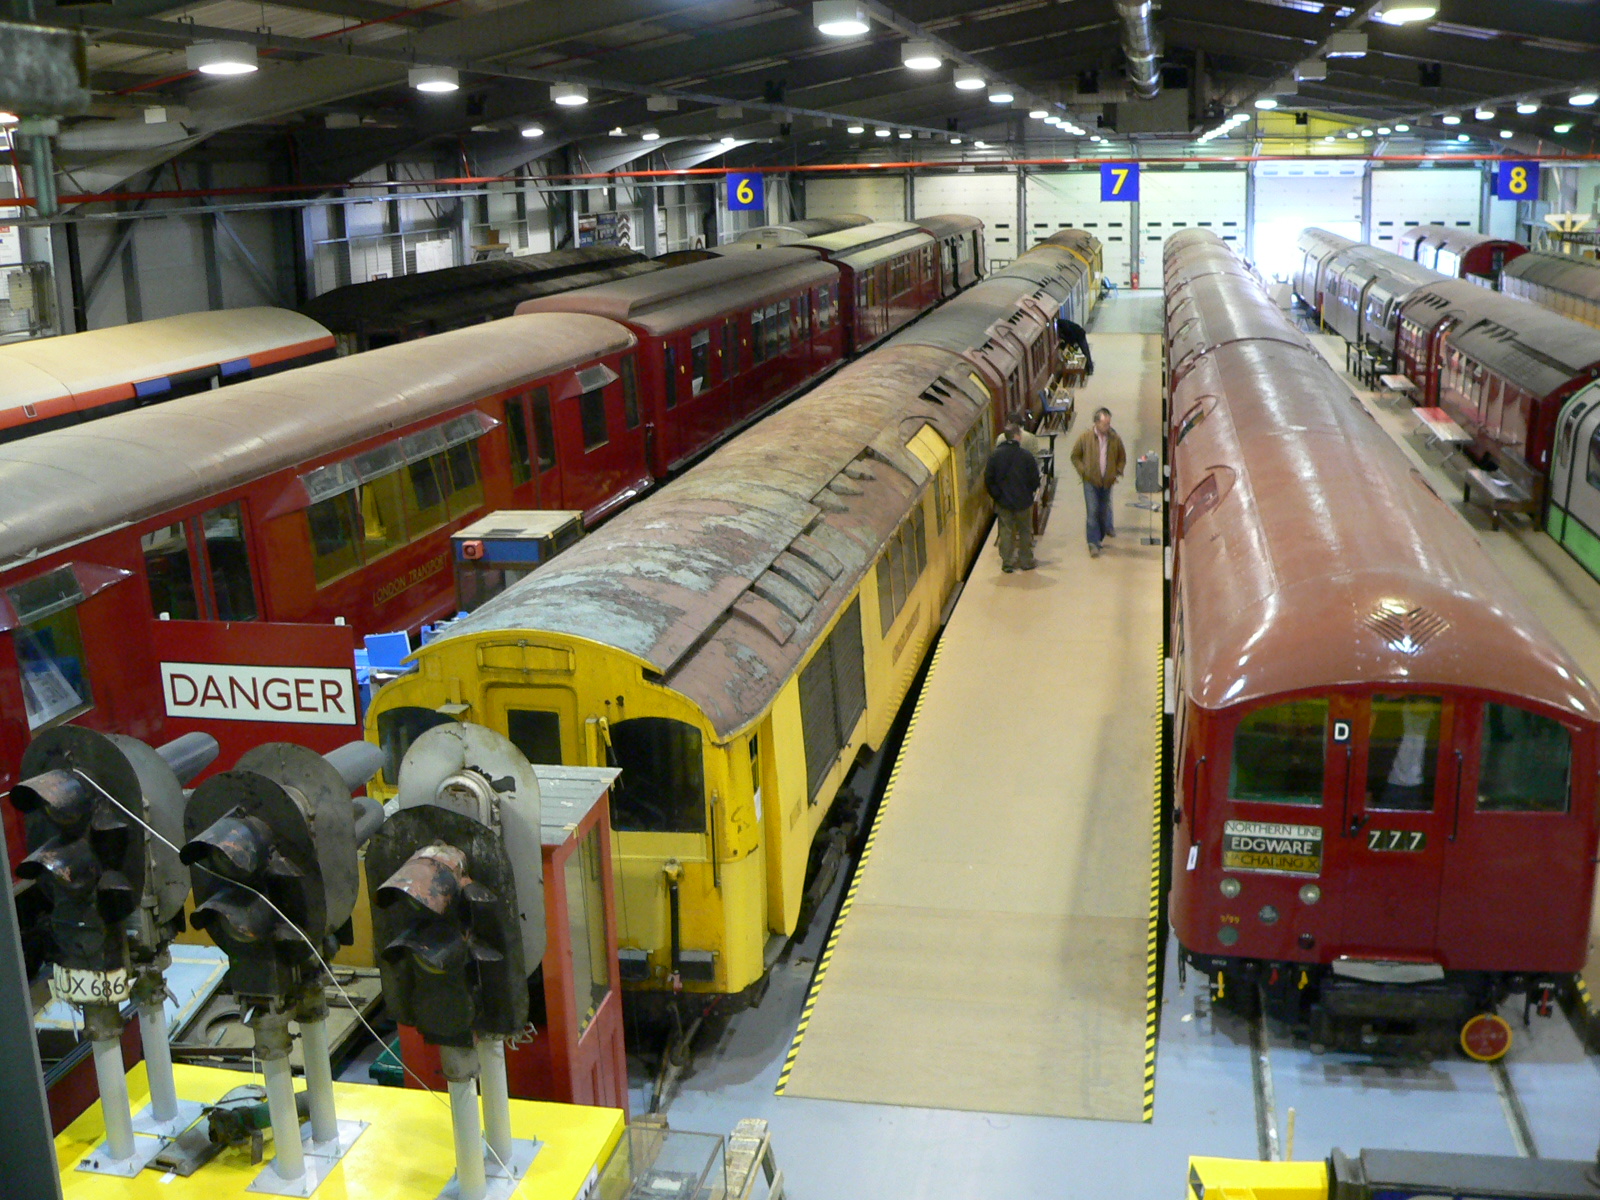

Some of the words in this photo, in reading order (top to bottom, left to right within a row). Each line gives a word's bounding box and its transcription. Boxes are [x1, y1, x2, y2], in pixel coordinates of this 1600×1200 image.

[736, 178, 754, 204] 6
[1111, 169, 1129, 195] 7
[1509, 166, 1527, 194] 8
[373, 574, 407, 608] LONDON
[408, 550, 449, 584] TRANSPORT
[170, 672, 346, 714] DANGER
[1334, 722, 1349, 740] D
[1225, 821, 1292, 836] NORTHERN
[1297, 826, 1322, 837] LINE
[1231, 836, 1313, 855] EDGWARE
[91, 976, 125, 998] 686
